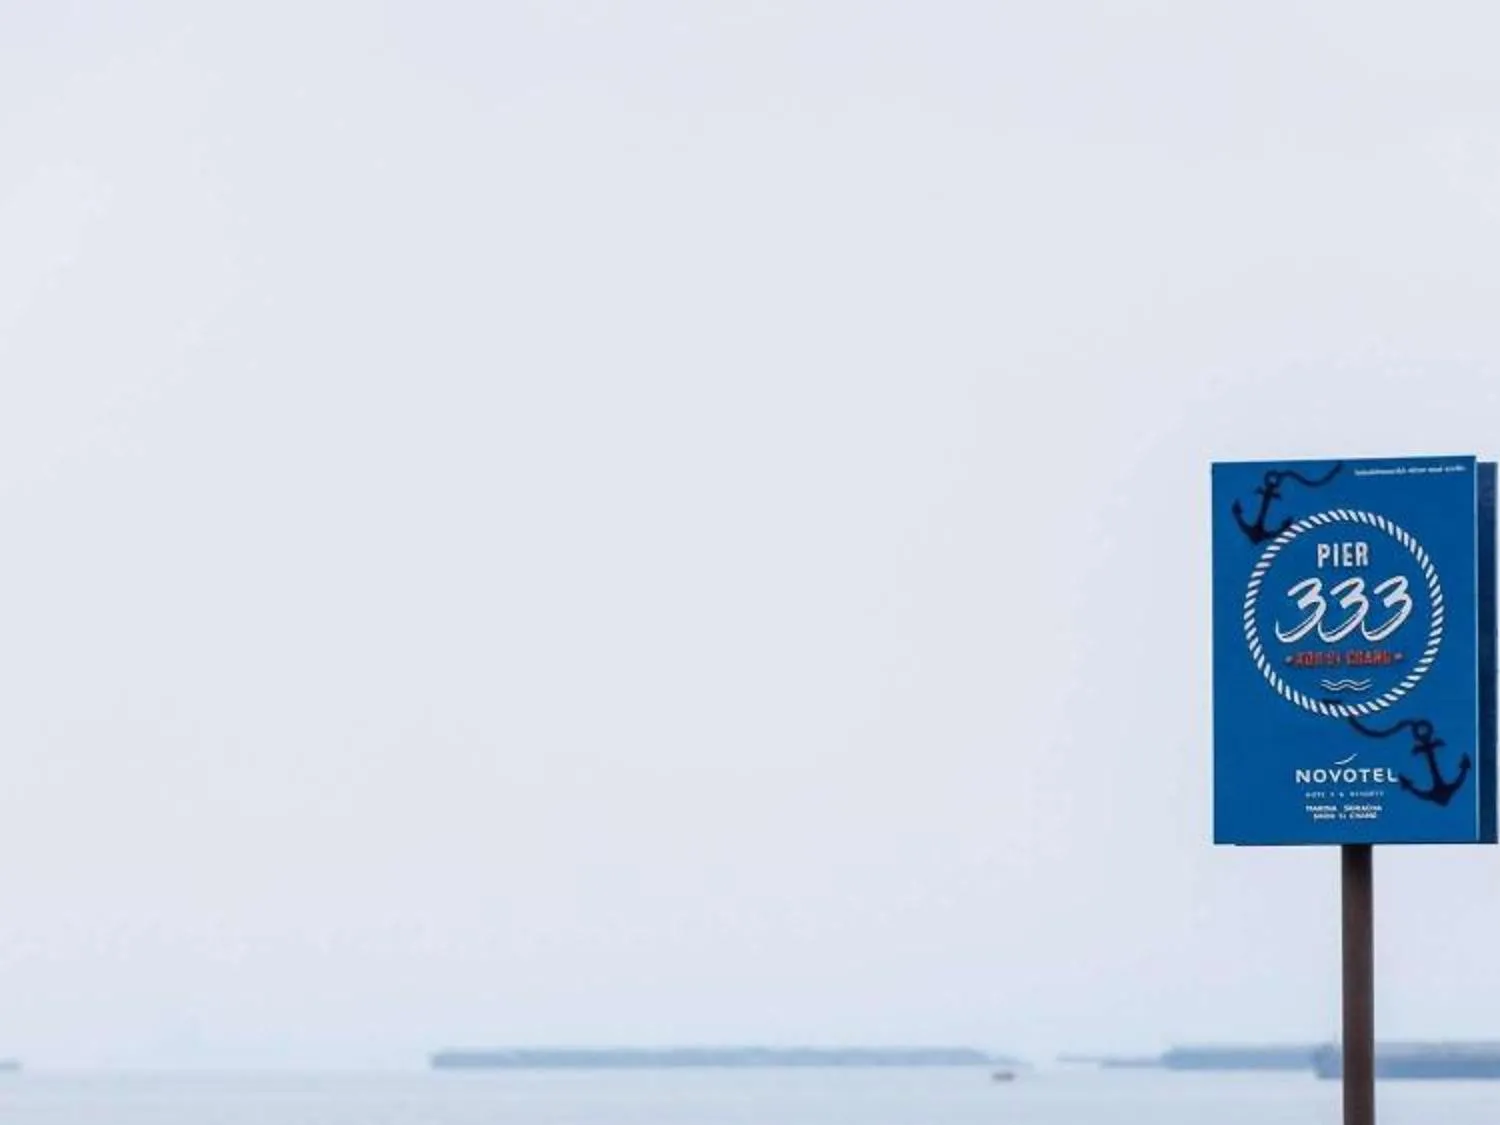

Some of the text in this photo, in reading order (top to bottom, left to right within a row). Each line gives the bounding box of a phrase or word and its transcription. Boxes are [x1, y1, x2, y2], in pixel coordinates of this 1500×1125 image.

[1317, 541, 1369, 568] PIER
[1275, 575, 1413, 643] 333
[1295, 767, 1399, 783] NOVOTEL
